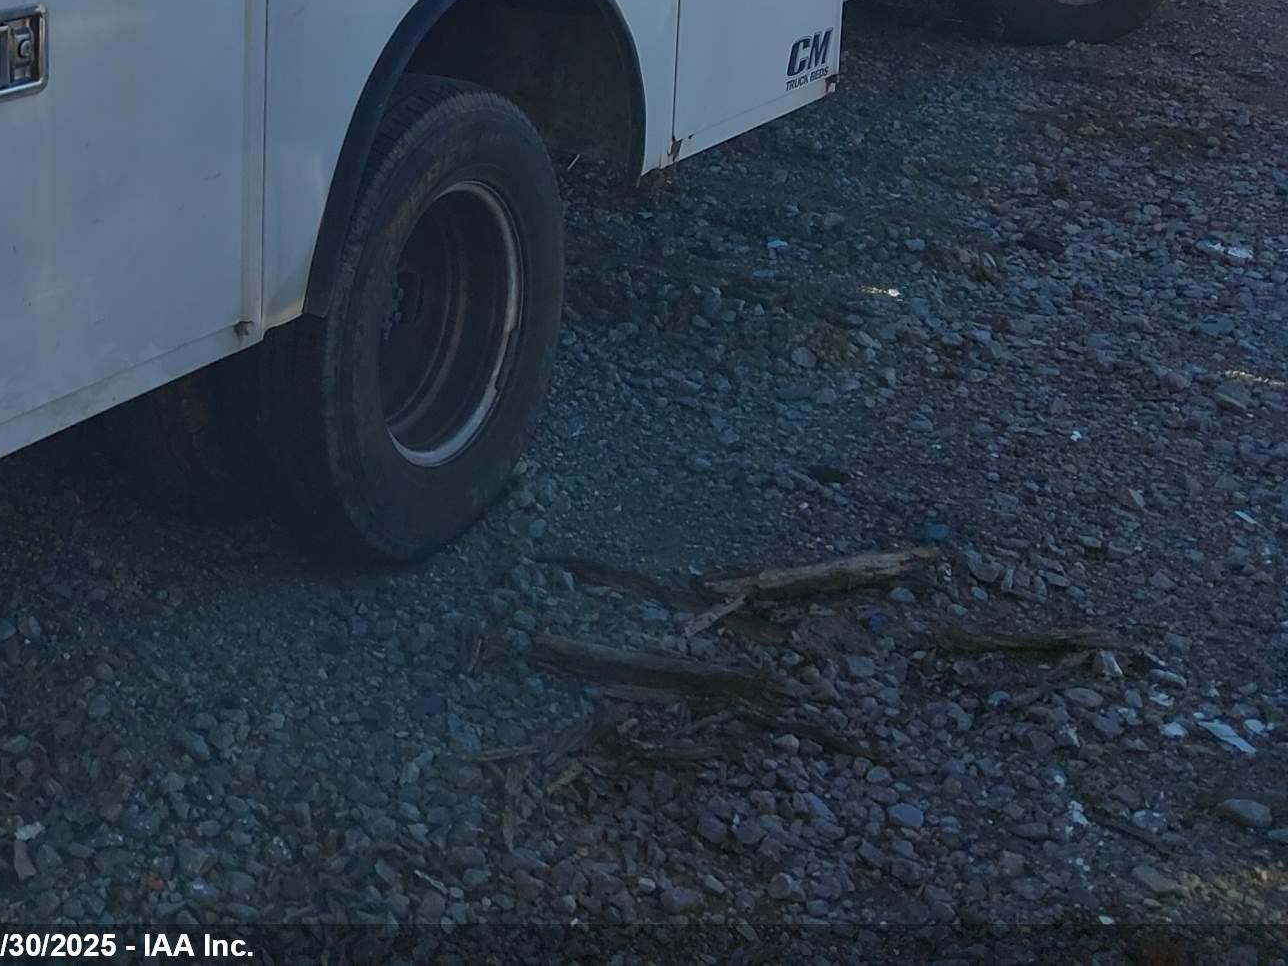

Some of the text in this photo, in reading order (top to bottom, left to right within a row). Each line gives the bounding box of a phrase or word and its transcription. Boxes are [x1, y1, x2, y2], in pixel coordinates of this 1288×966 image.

[786, 30, 833, 77] CM
[786, 66, 830, 91] TRUCK BEDS
